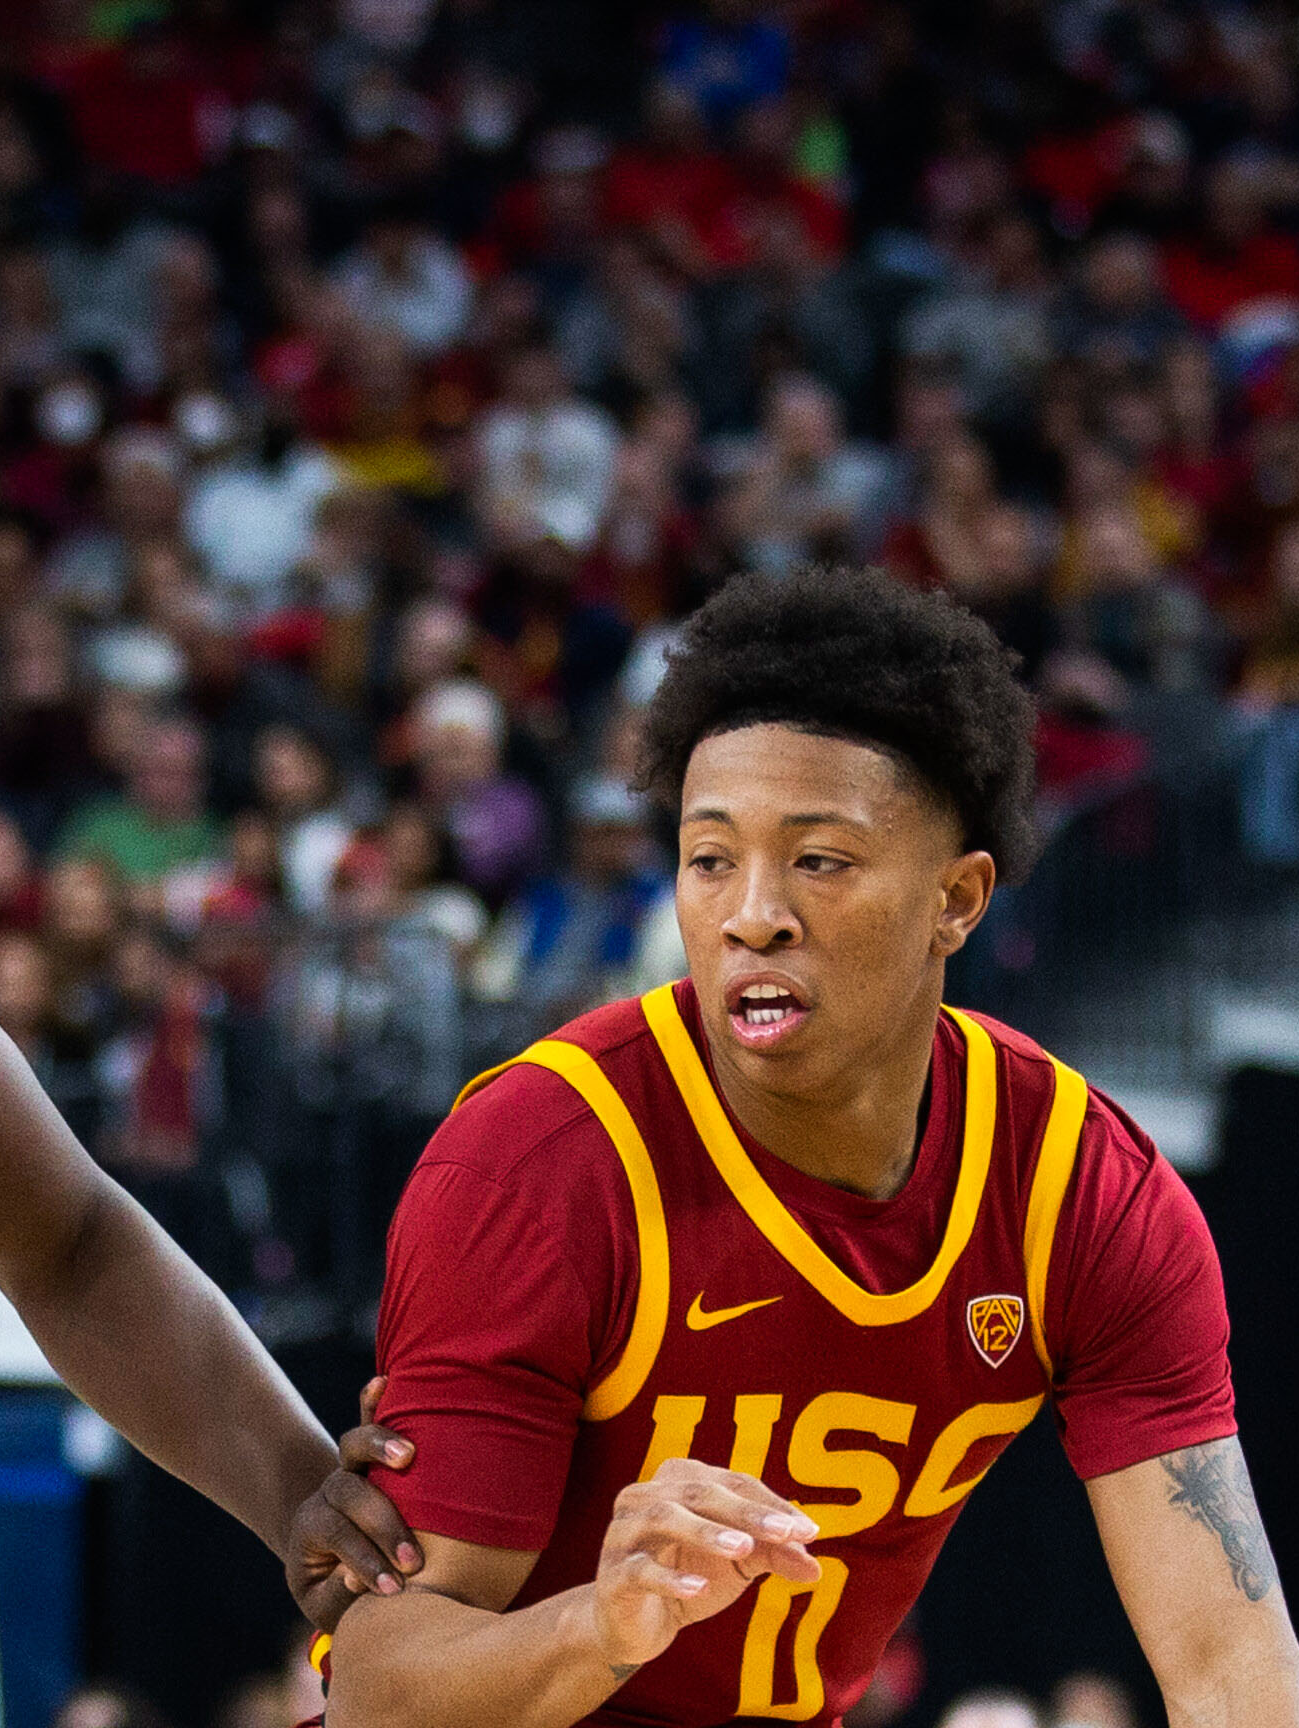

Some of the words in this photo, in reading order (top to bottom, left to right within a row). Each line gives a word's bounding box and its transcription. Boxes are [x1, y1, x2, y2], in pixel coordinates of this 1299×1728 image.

[972, 1299, 1021, 1339] PAC
[983, 1325, 1009, 1352] 12
[734, 1555, 849, 1722] 0
